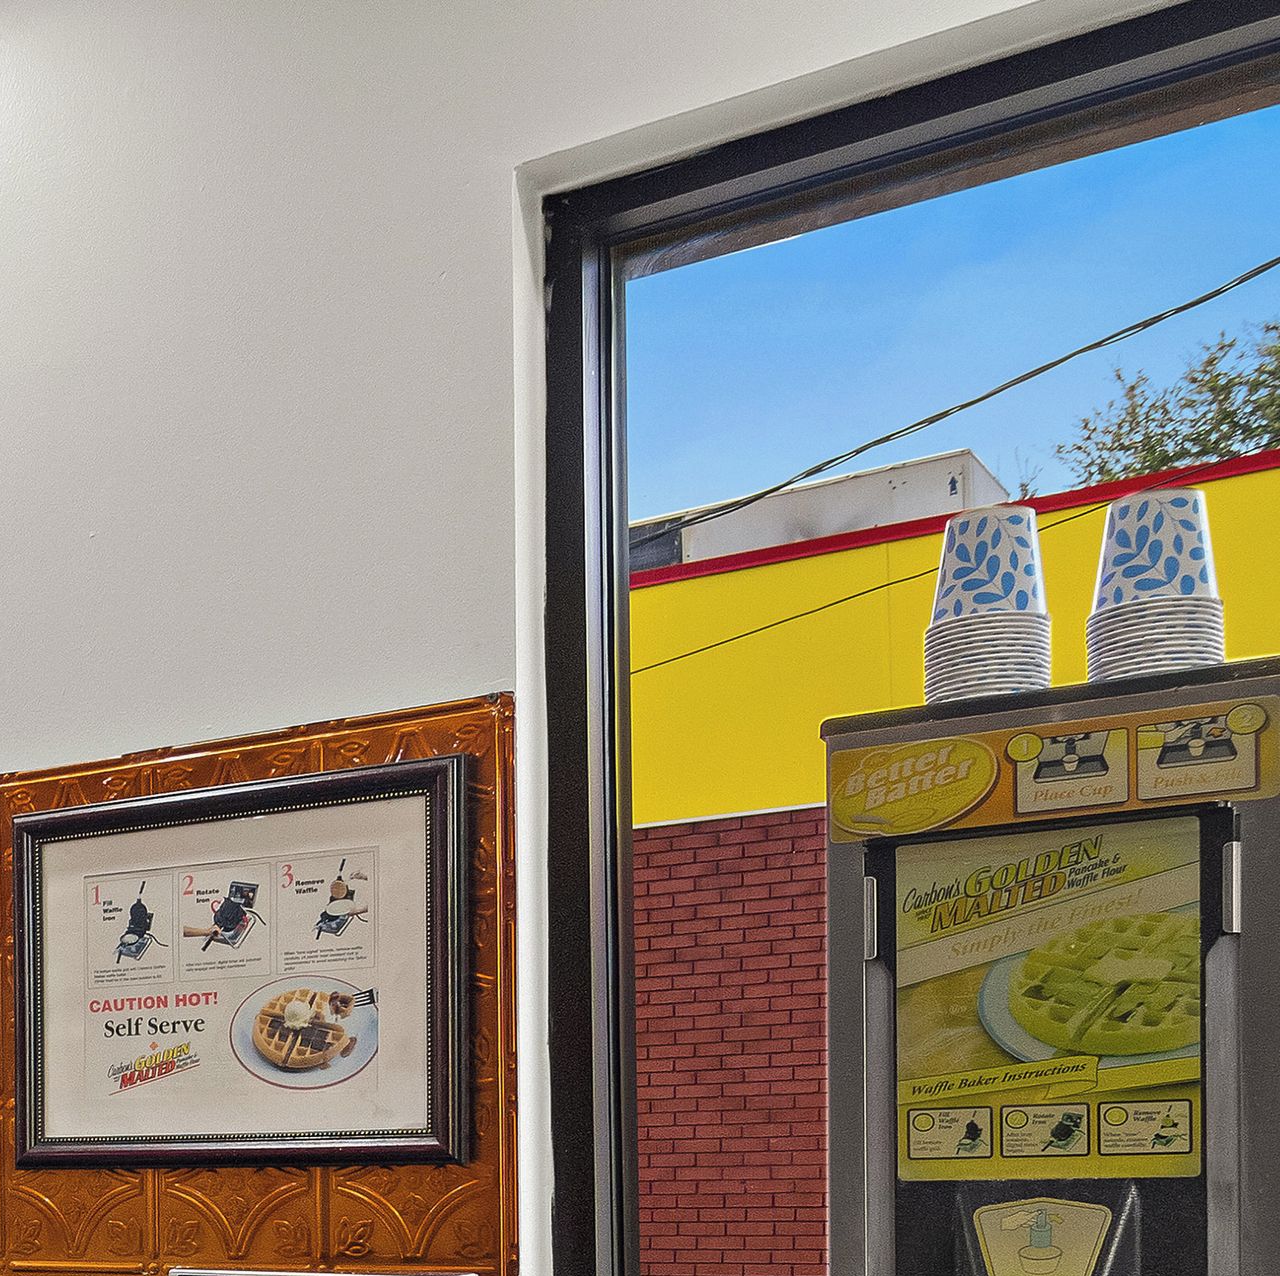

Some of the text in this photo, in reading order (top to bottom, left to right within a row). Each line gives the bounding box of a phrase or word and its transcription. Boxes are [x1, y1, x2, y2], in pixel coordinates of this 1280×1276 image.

[845, 745, 954, 796] Better
[1152, 770, 1193, 789] Push
[865, 758, 976, 810] Batter
[1032, 783, 1115, 802] Place Cup
[281, 864, 294, 889] 3
[964, 834, 1103, 898] GOLDEN
[1067, 863, 1128, 890] Waffle Flour
[1068, 853, 1120, 877] Pancake &
[183, 875, 194, 896] 2
[196, 887, 220, 896] Rotate
[295, 878, 325, 887] Remove
[295, 887, 319, 895] Waffle
[91, 885, 101, 905] 1
[903, 877, 961, 914] Carbon's
[931, 871, 1068, 934] MALTED
[89, 992, 218, 1013] CAUTION HOT!
[104, 1017, 206, 1038] Self Serve
[134, 1041, 191, 1071] GOLDEN
[120, 1059, 177, 1089] MALTED
[911, 1062, 1088, 1096] Waffle Baker Instructions
